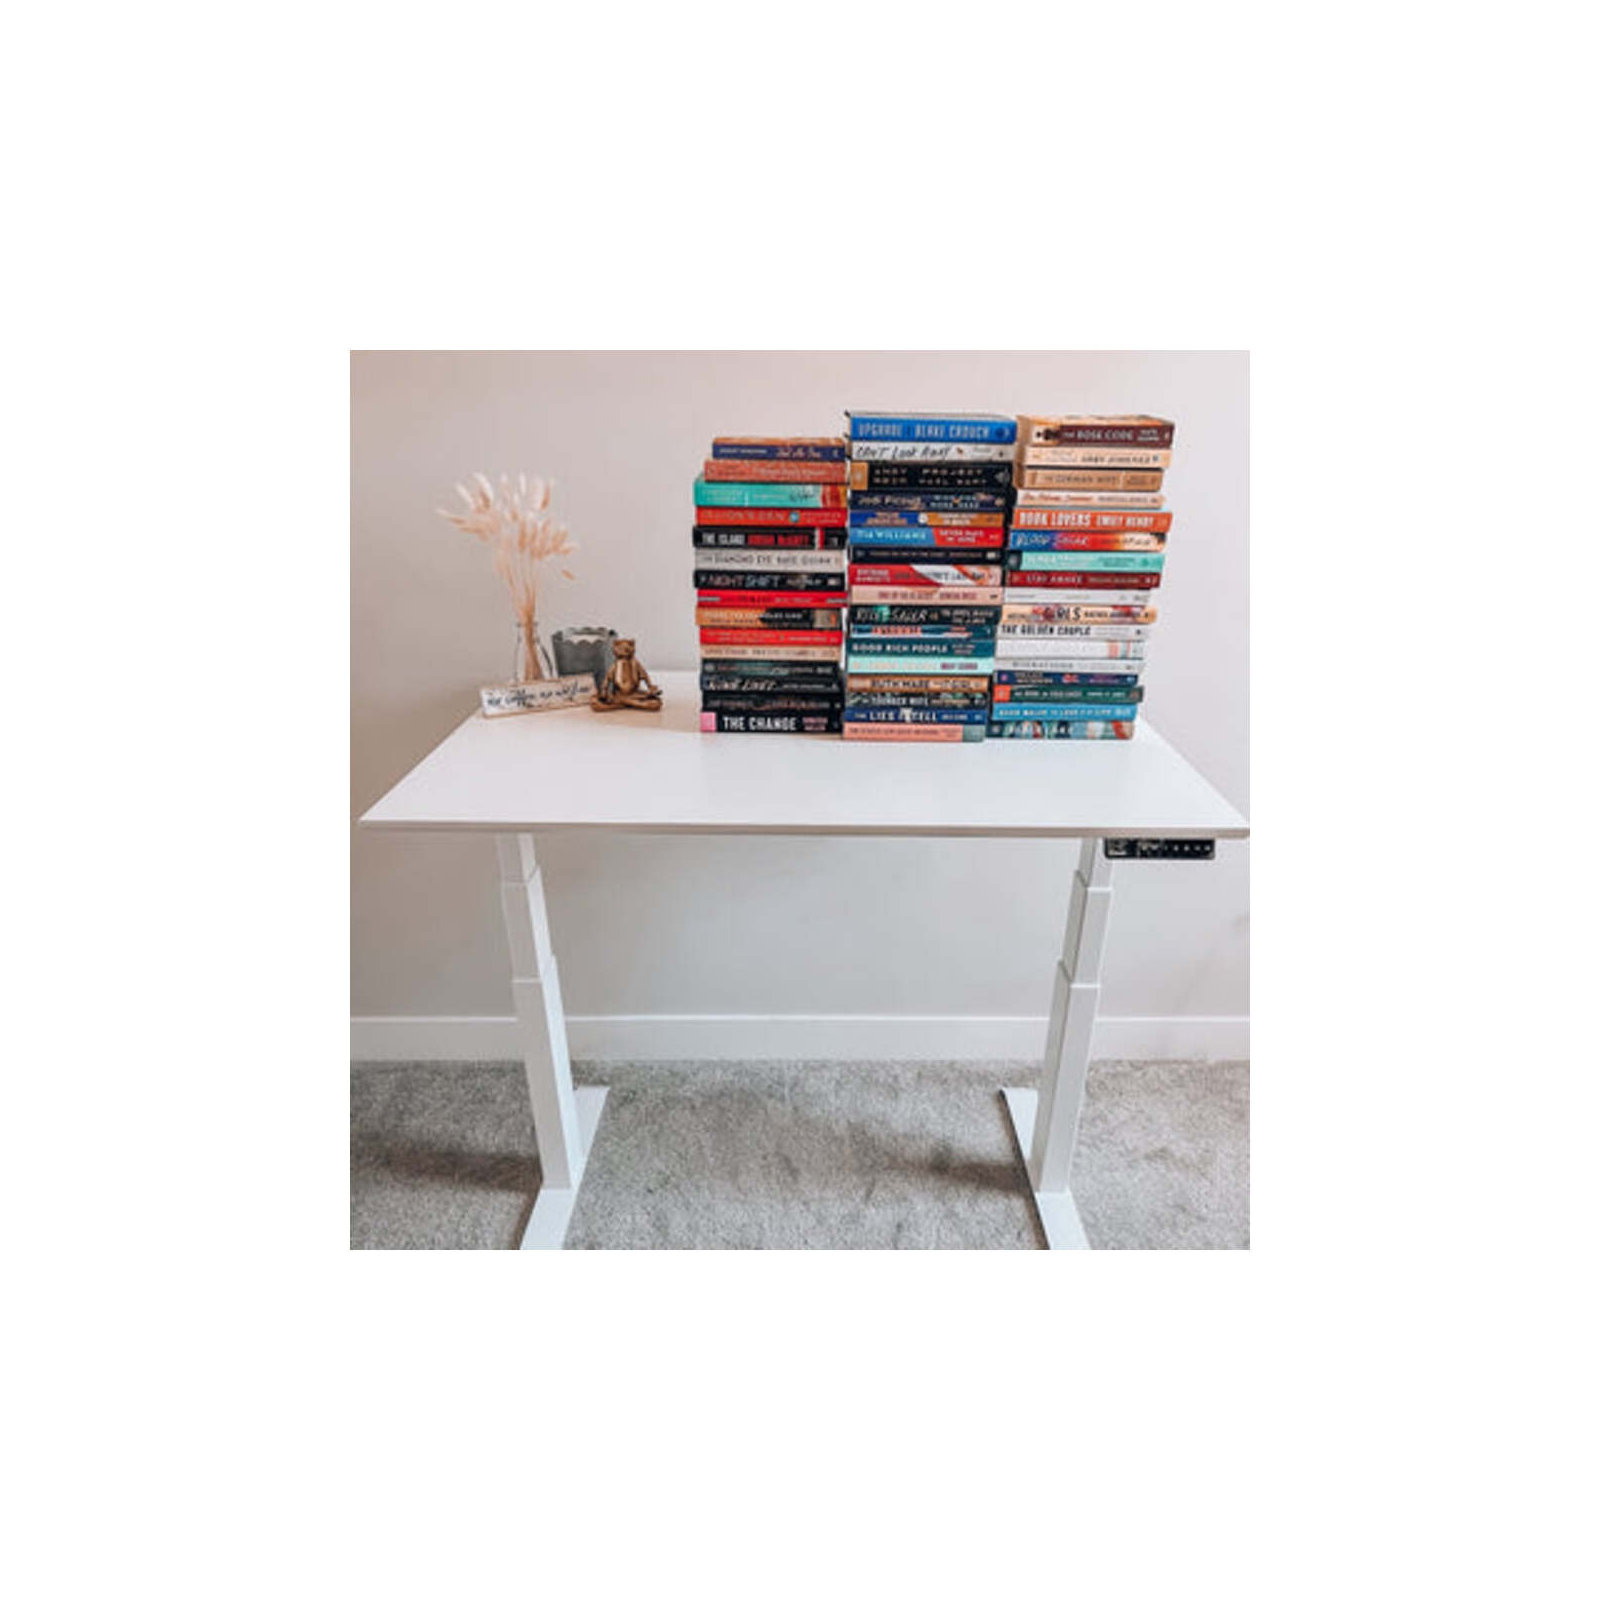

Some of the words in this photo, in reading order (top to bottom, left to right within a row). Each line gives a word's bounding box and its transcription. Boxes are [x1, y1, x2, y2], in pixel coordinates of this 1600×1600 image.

[858, 424, 902, 437] UPGRADE
[949, 426, 990, 439] CROUCH
[1077, 429, 1103, 439] ROSE
[1105, 429, 1133, 439] CODE
[1019, 511, 1048, 526] BOOK
[1050, 511, 1091, 526] LOVERS
[1096, 514, 1122, 526] EMILY
[1001, 624, 1017, 635] THE
[1020, 625, 1054, 636] GOLDEN
[1057, 626, 1091, 637] COUPLE
[911, 644, 948, 653] PEOPLE
[722, 717, 745, 731] THE
[749, 717, 798, 731] CHANGE
